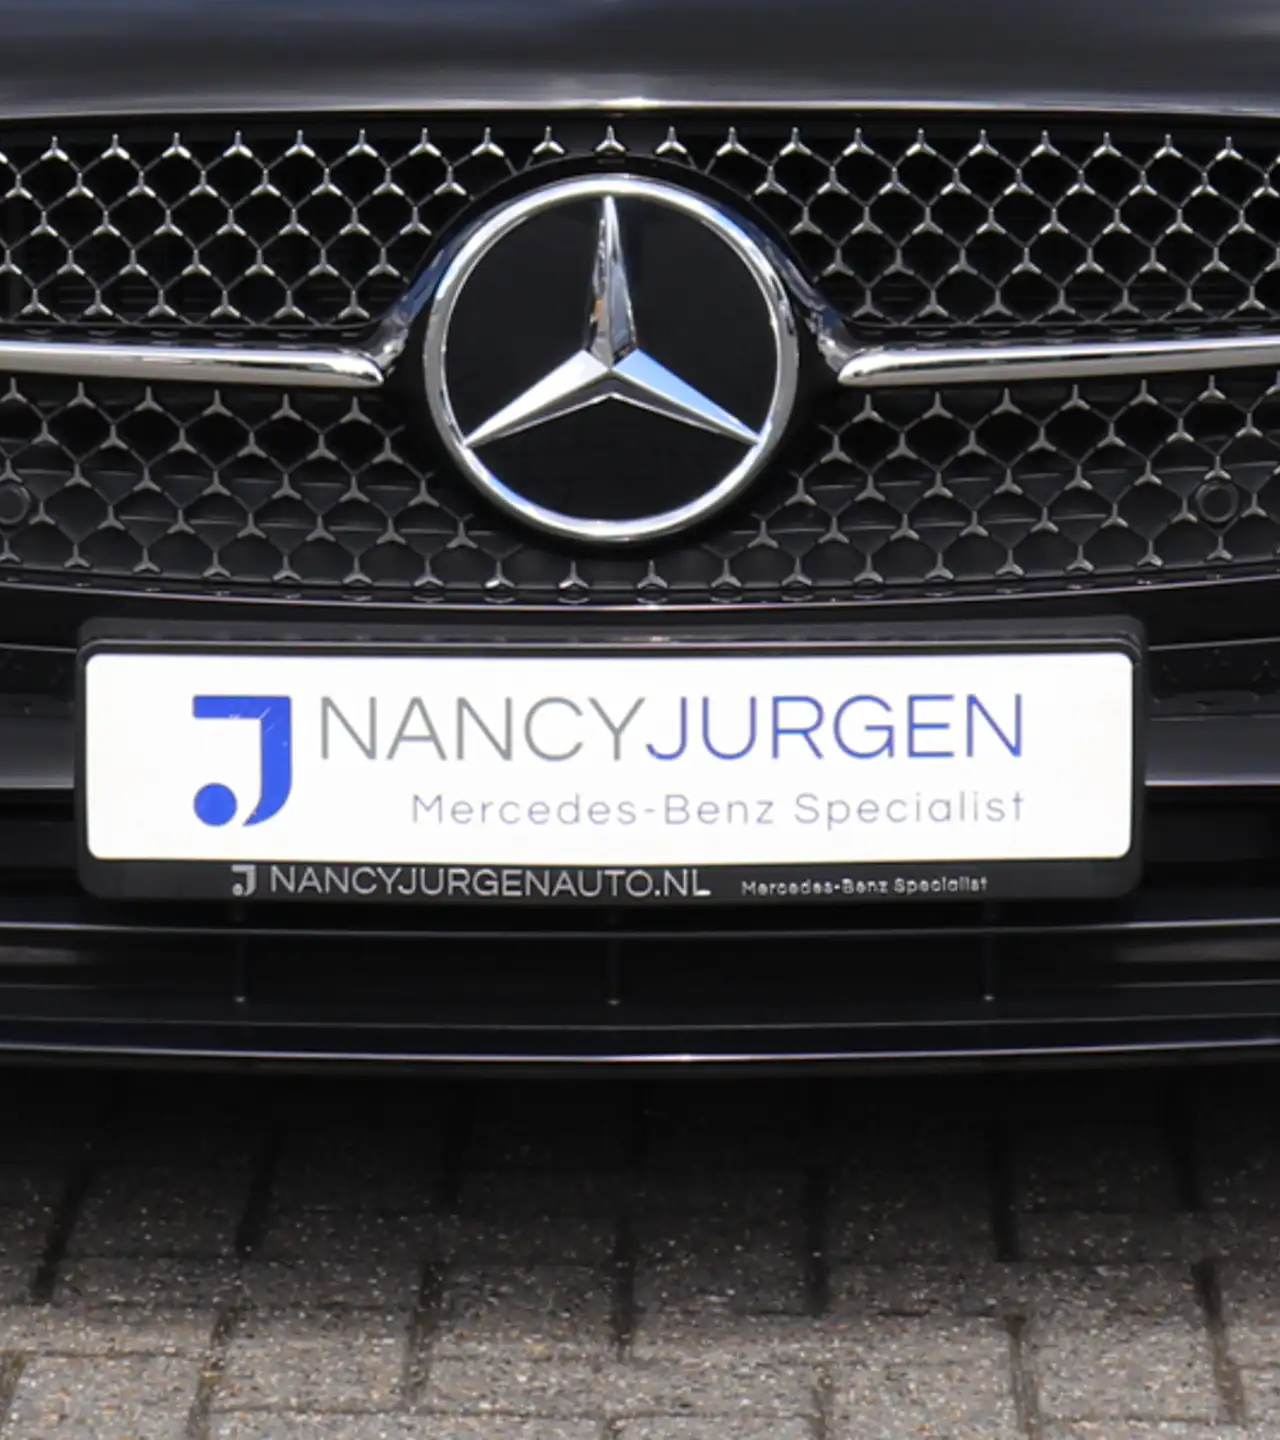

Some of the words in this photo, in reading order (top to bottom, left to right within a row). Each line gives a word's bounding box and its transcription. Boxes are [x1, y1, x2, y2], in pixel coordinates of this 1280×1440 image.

[320, 693, 1023, 761] NANCYJURGEN
[412, 792, 776, 825] Mercedes-Benz
[793, 790, 1025, 831] Specialist
[269, 865, 712, 897] NANCYJURGENAUTO.NL
[740, 877, 888, 897] Mercedes-Benz
[893, 876, 988, 896] Specialist
